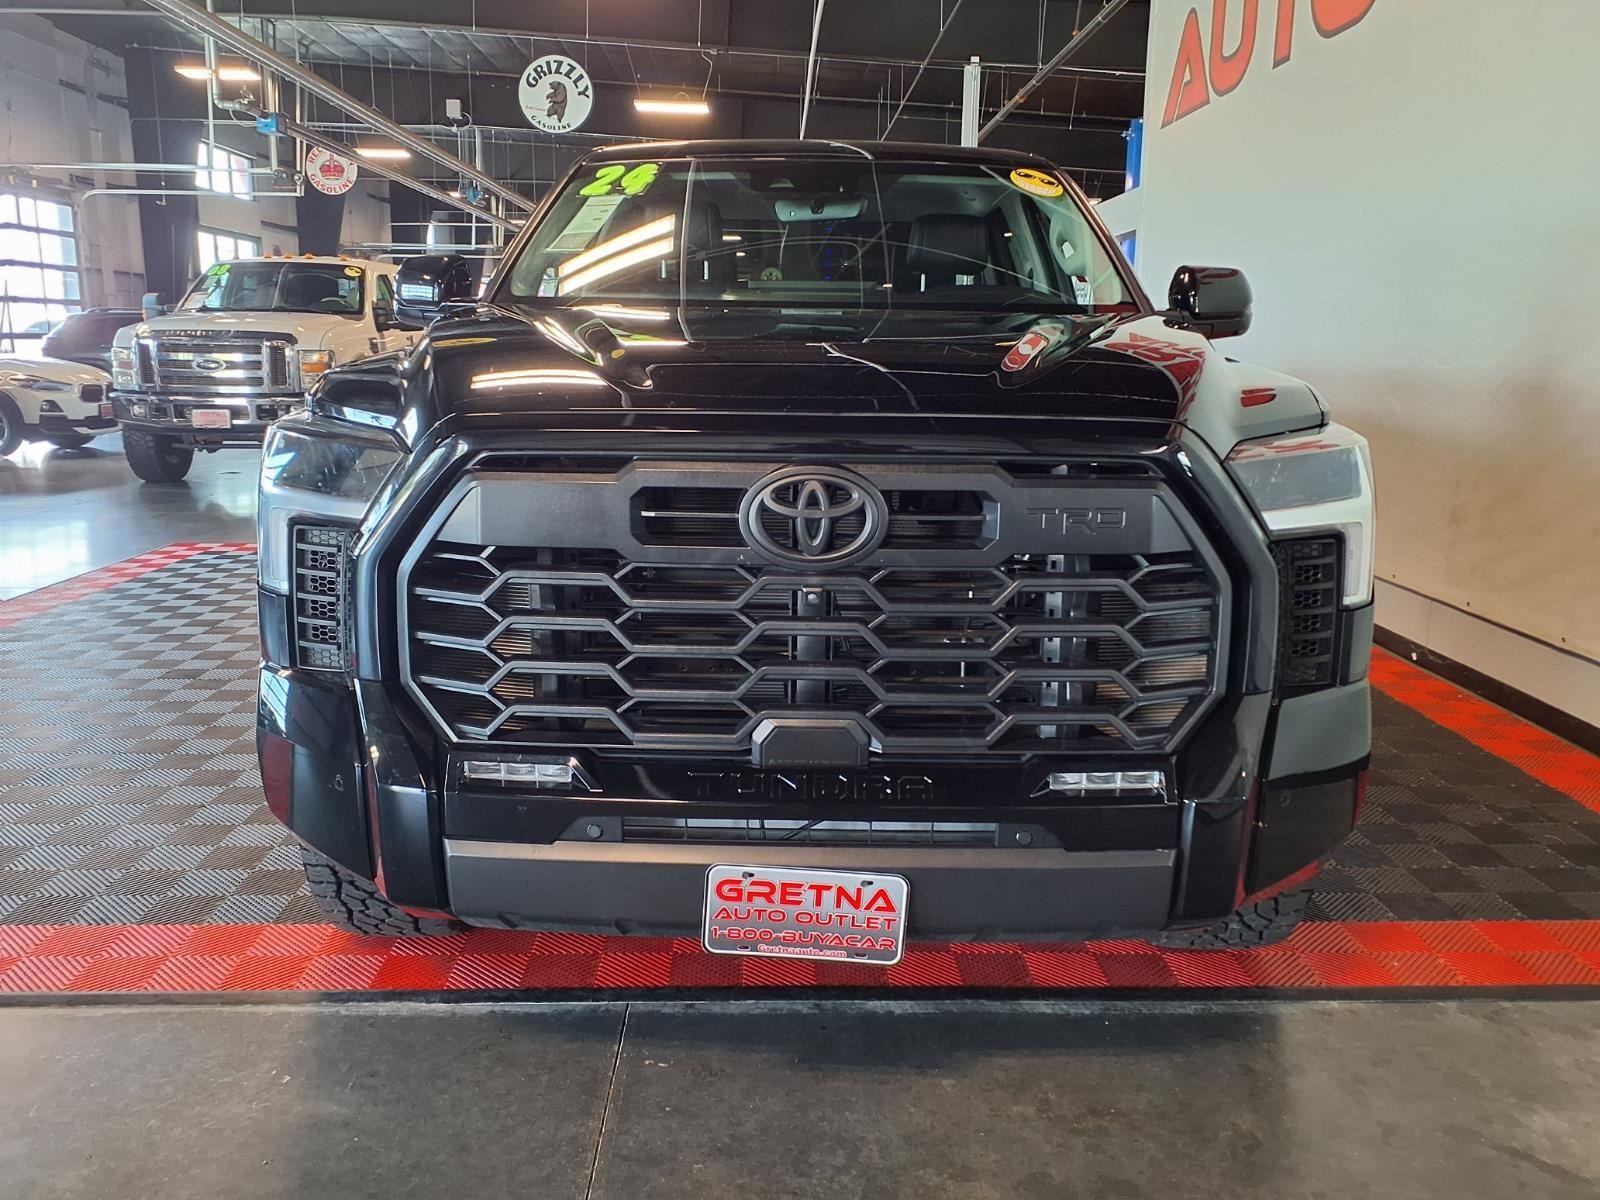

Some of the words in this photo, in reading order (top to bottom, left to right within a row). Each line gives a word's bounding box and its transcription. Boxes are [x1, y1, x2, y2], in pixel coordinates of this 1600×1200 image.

[1160, 0, 1377, 129] AUT
[525, 60, 590, 99] GRIZZLY
[531, 115, 573, 131] GASOLINE
[309, 173, 354, 194] GASOLINE
[579, 163, 660, 197] 24
[1026, 507, 1126, 535] TRD
[688, 772, 932, 799] TUNDRA
[714, 877, 897, 913] GRETNA
[712, 906, 787, 923] AUTO
[794, 911, 899, 931] OUTLET
[711, 926, 896, 951] 1-800-BUYACAR
